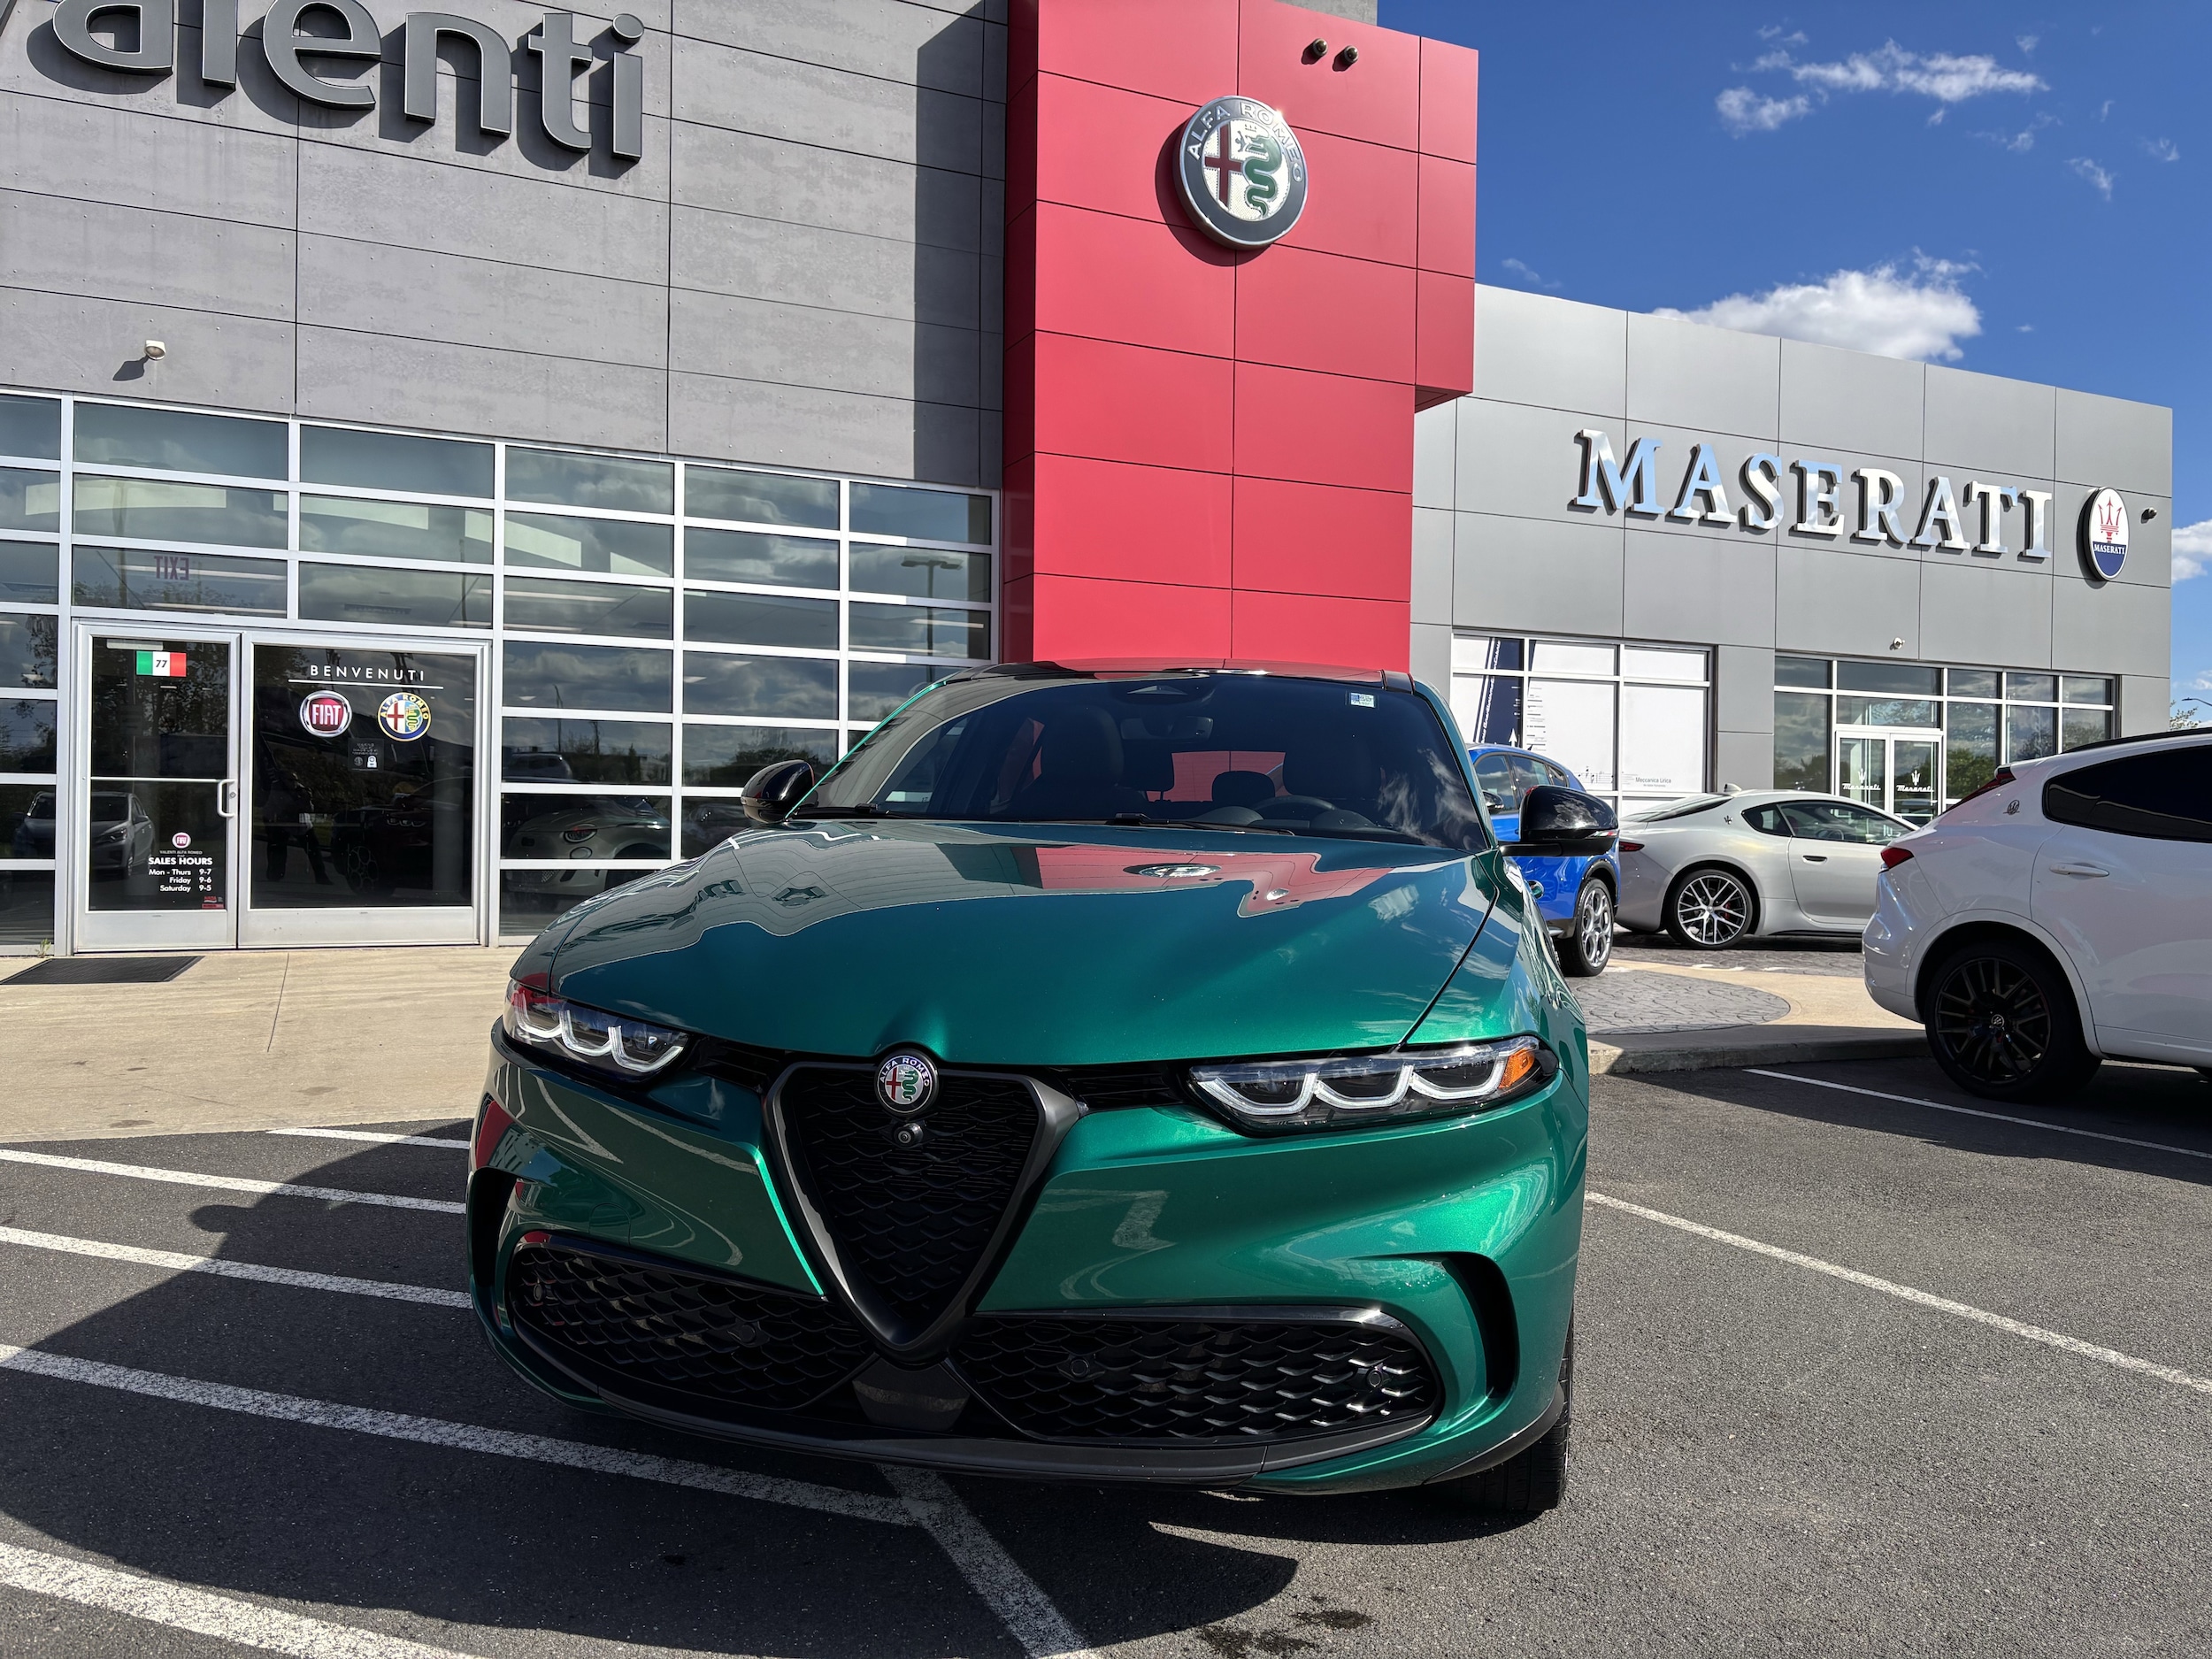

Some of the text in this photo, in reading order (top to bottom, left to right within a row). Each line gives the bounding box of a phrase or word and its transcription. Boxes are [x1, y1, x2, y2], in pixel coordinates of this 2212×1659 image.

[0, 0, 645, 162] alenti
[1187, 102, 1302, 182] ALFA ROMEO
[1571, 428, 2053, 559] MASERATI
[2093, 543, 2125, 555] MASERATI
[156, 659, 167, 669] 77
[311, 664, 424, 681] BENVENUTI
[311, 703, 342, 726] FIAT
[380, 694, 429, 720] ALFA ROMEO
[148, 856, 213, 865] SALES HOURS
[169, 876, 191, 885] Friday
[879, 1057, 930, 1087] ALFA ROMEO
